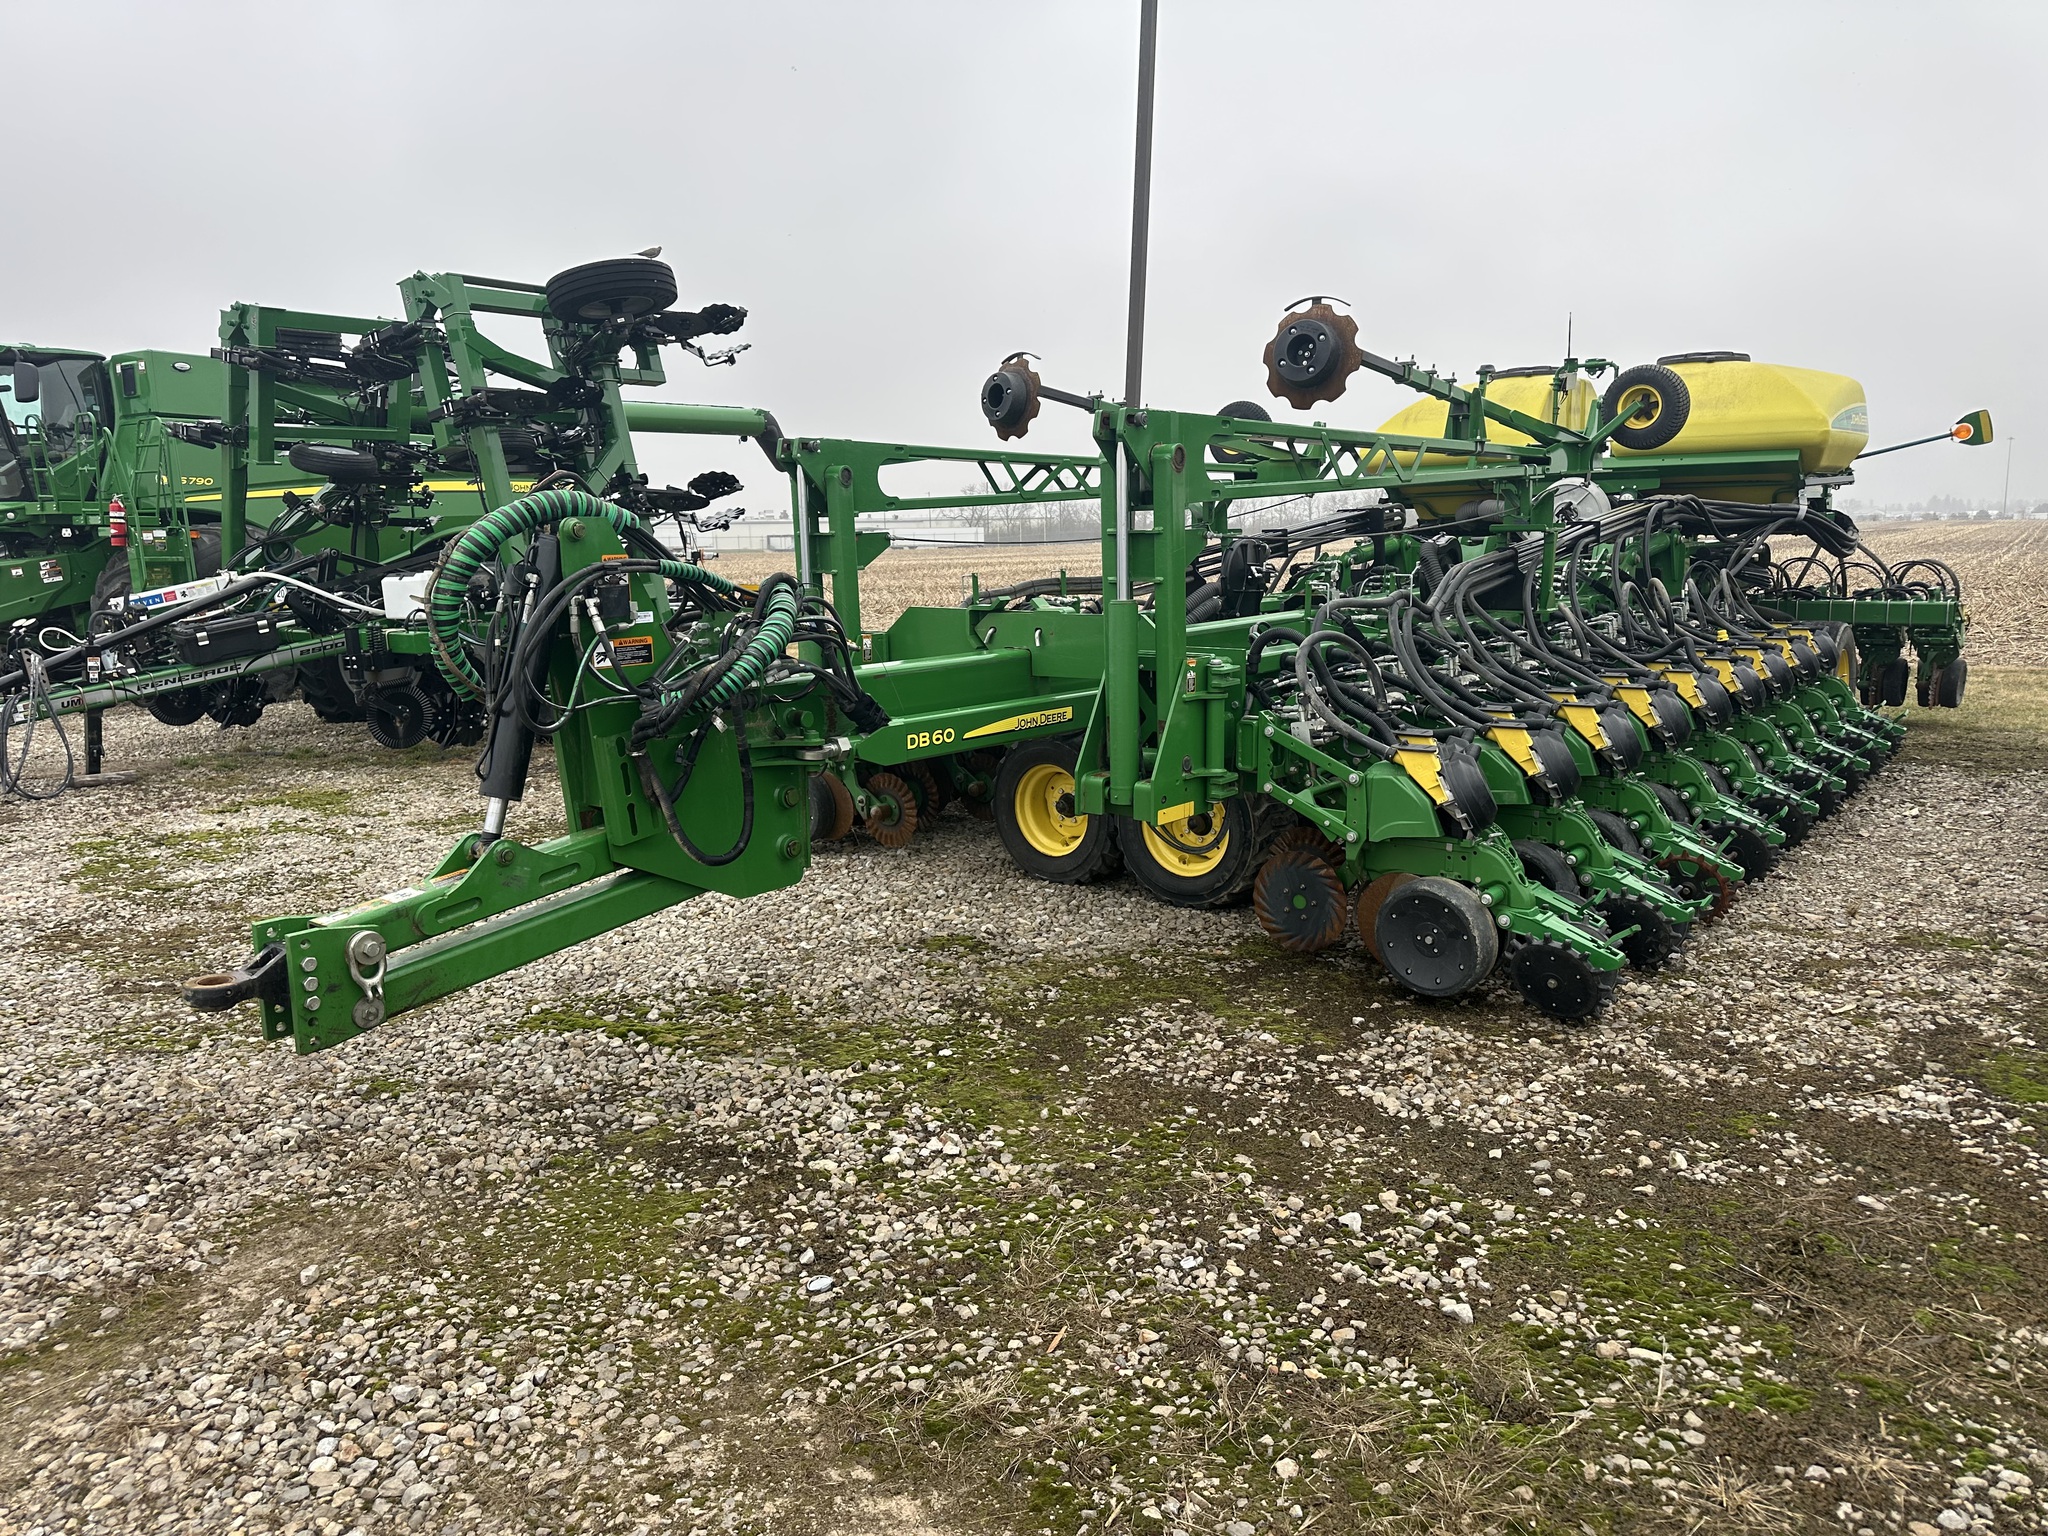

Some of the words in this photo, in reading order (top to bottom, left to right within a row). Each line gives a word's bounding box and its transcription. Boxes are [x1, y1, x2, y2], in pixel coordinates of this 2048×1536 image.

[137, 663, 241, 691] RENEGADE
[1015, 716, 1038, 729] JOHN
[1040, 711, 1067, 724] DEERE
[907, 732, 930, 750] DB
[932, 727, 955, 745] 60
